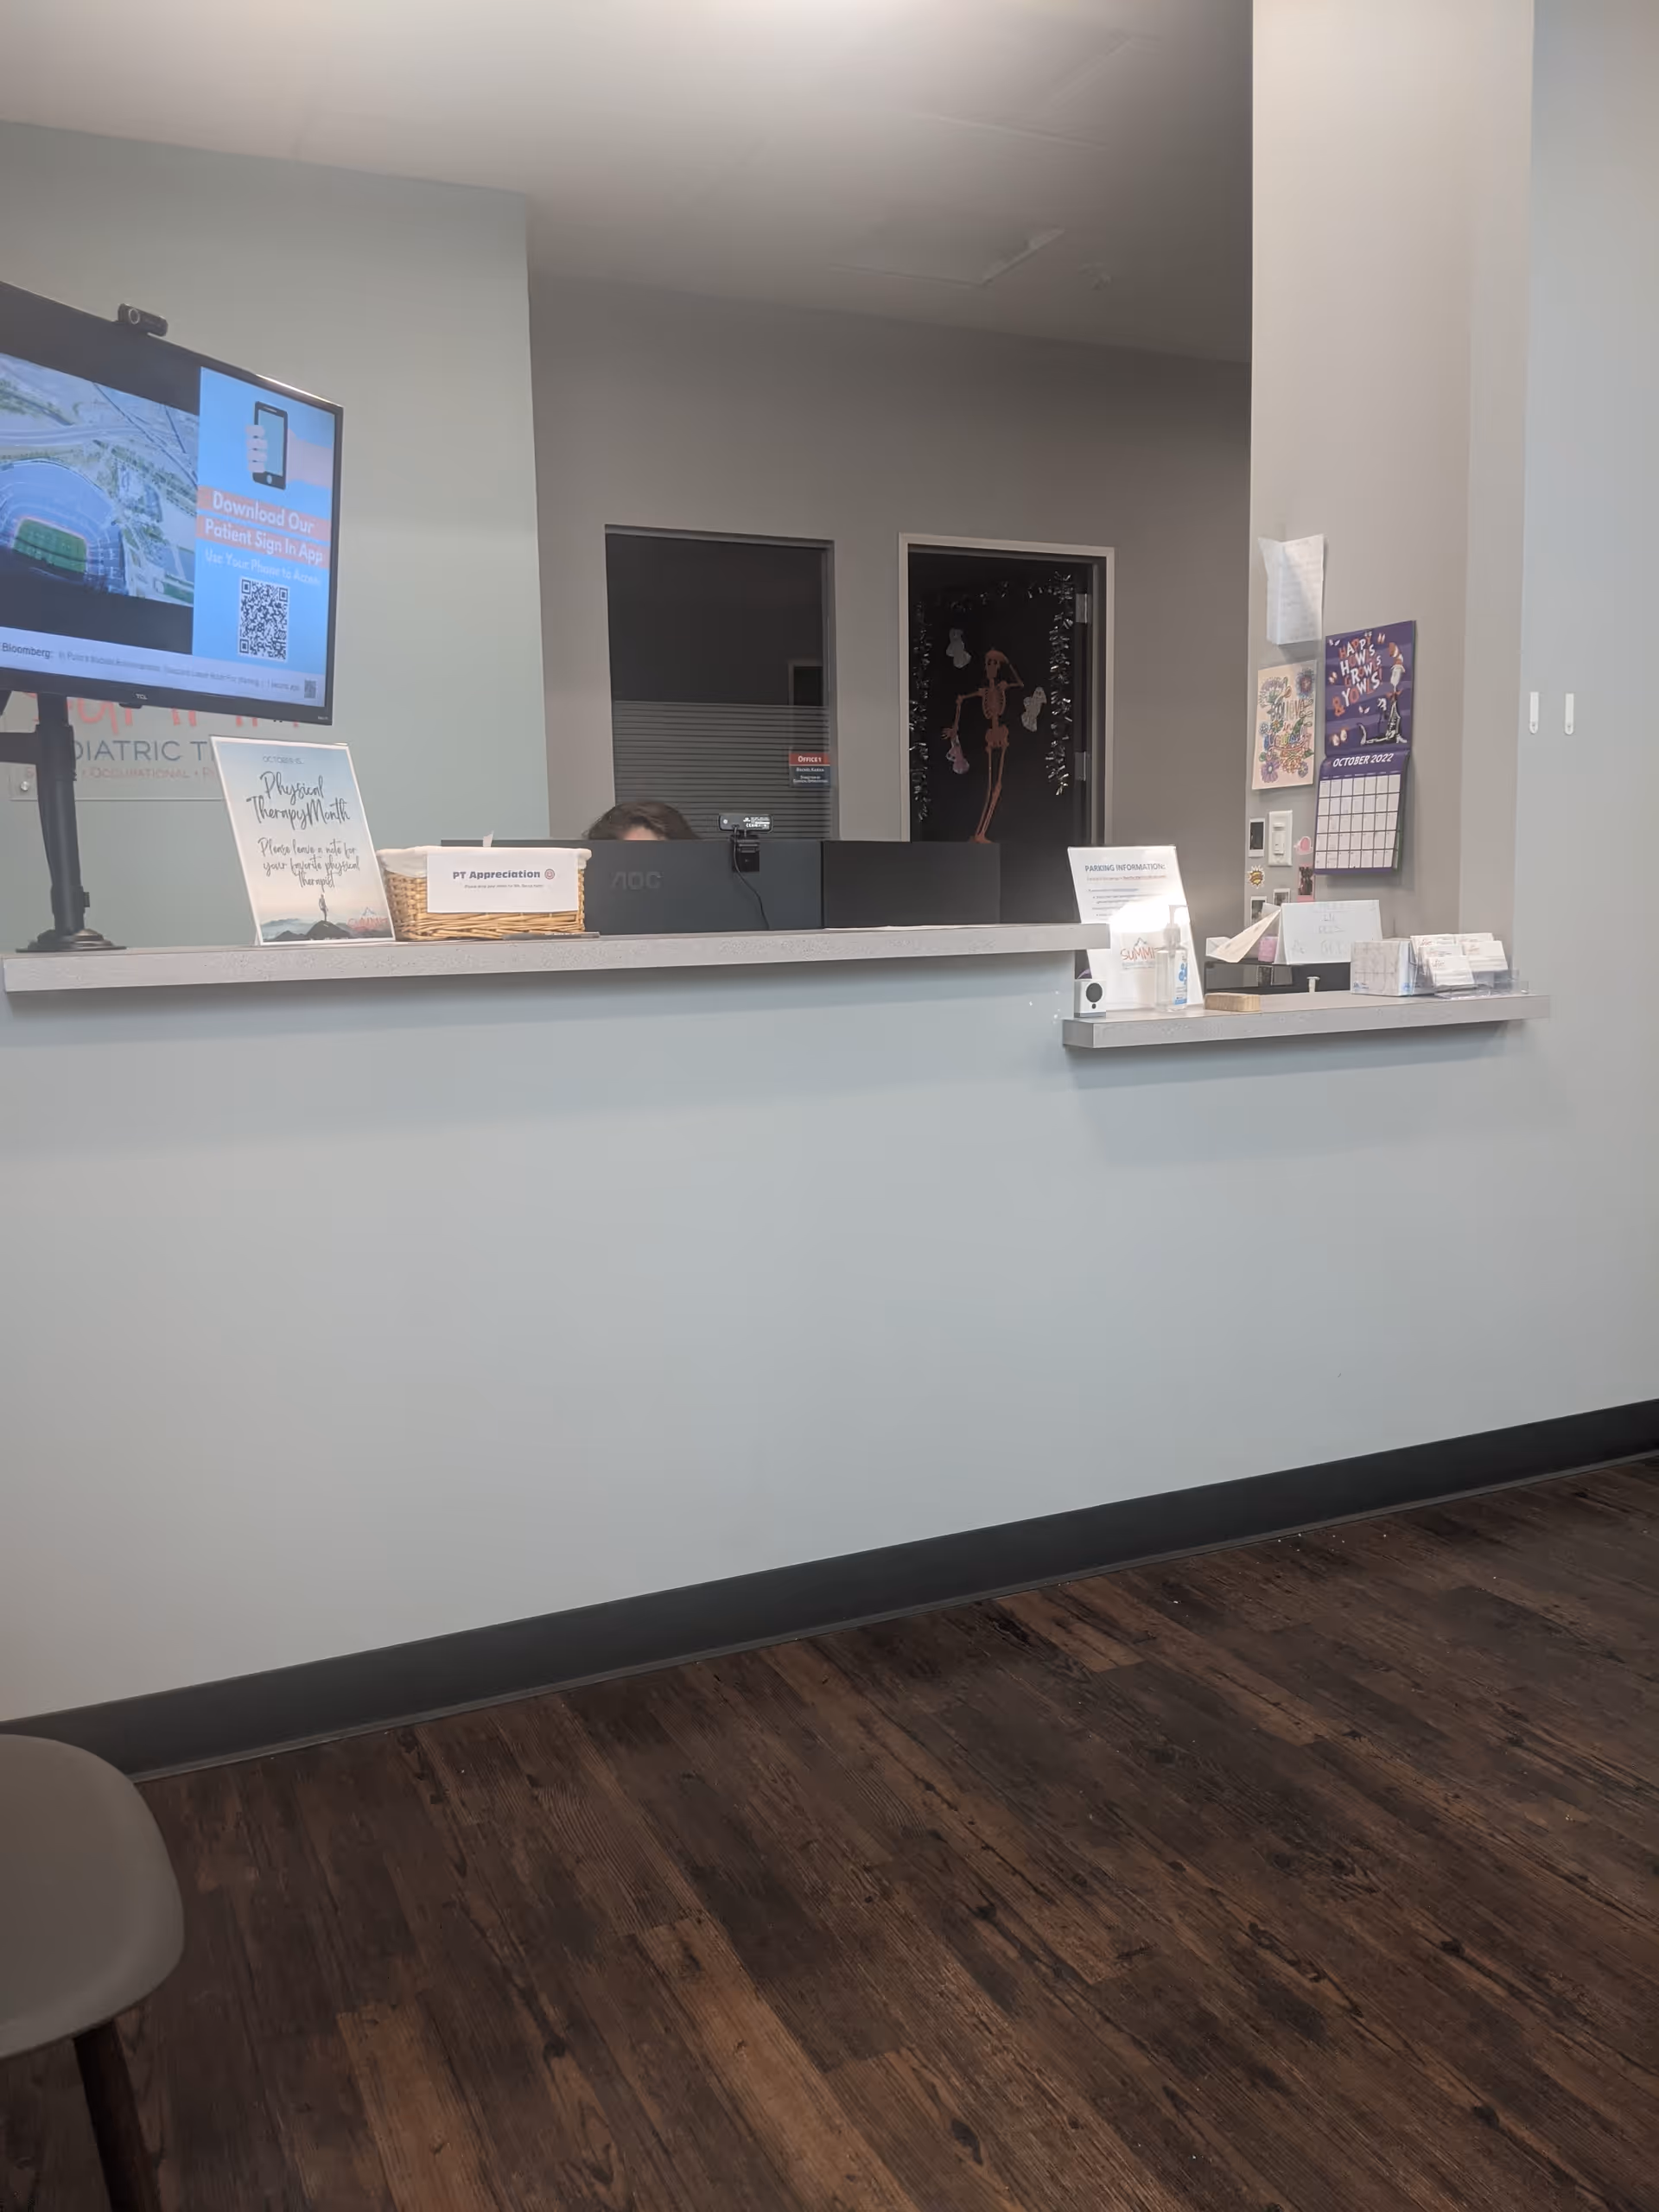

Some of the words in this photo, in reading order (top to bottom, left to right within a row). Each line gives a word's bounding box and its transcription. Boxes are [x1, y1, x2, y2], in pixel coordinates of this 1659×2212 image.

[213, 490, 285, 526] Download
[289, 512, 315, 534] Our
[205, 518, 251, 545] Patient
[255, 531, 283, 555] Sign
[285, 538, 296, 556] In
[298, 543, 323, 566] App
[2, 642, 51, 660] Bloomberg
[1339, 635, 1372, 659] HAPPY
[1340, 644, 1376, 677] HOWLS
[1332, 696, 1345, 717] &
[1332, 755, 1370, 767] OCTOBER
[1371, 753, 1394, 764] 2022
[259, 771, 324, 806] Physical
[257, 837, 291, 857] Please
[292, 839, 315, 855] leave
[326, 839, 342, 856] note
[344, 842, 357, 860] for
[263, 861, 288, 877] your
[289, 855, 322, 877] favorite
[324, 855, 360, 877] physical
[453, 871, 467, 880] PT
[468, 869, 541, 880] Appreciation
[1116, 862, 1166, 872] INFORMATION:
[608, 871, 664, 890] AOC
[1120, 946, 1158, 962] SUMMI
